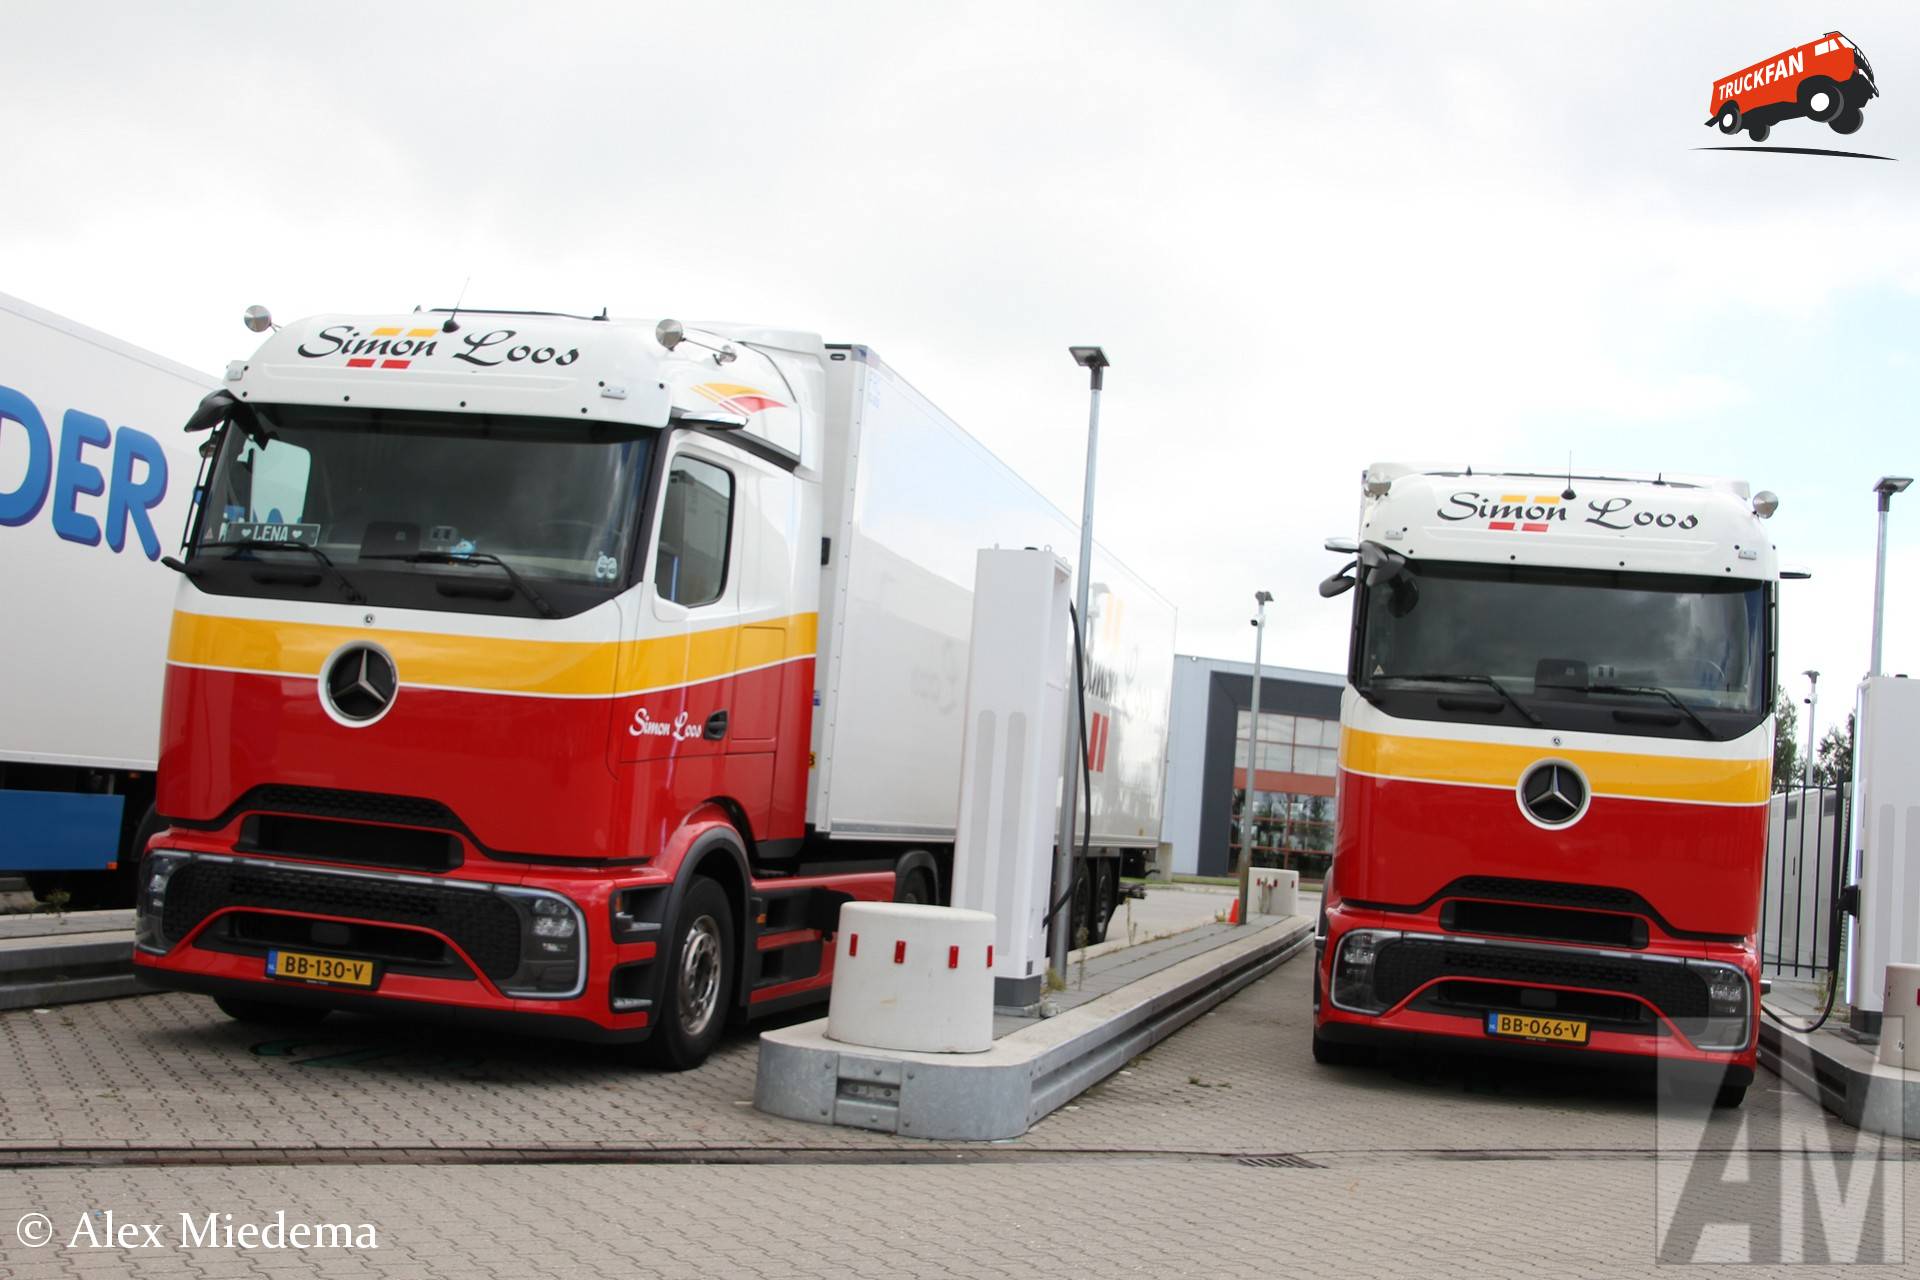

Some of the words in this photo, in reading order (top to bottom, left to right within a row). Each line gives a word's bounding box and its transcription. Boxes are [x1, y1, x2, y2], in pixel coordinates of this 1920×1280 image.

[298, 325, 438, 359] Simon
[452, 330, 580, 366] Loos
[1437, 491, 1567, 521] Simon
[1585, 497, 1699, 530] Loos
[252, 525, 289, 541] LENA
[628, 707, 671, 737] Simon
[672, 711, 702, 742] Loos
[284, 955, 364, 981] BB-130-V
[1501, 1017, 1580, 1039] BB-066-V
